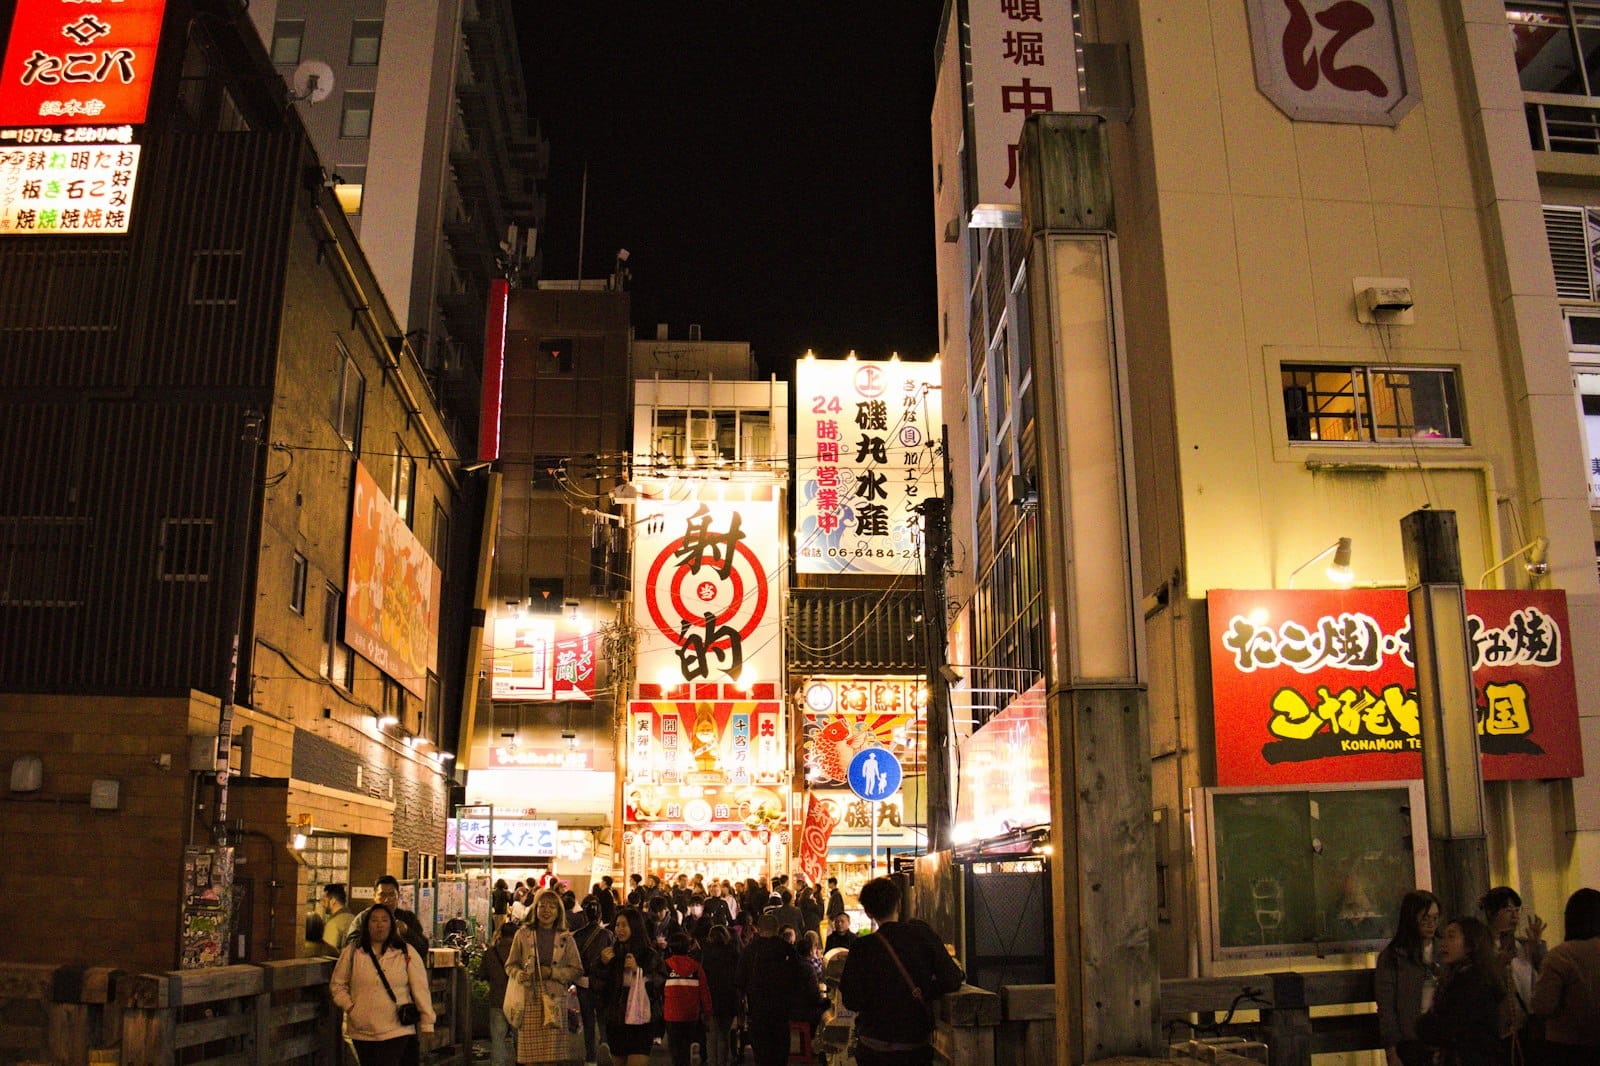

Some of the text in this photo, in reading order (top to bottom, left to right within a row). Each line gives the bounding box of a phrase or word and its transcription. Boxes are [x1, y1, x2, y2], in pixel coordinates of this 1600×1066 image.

[15, 150, 46, 229] 鉄板焼
[60, 150, 91, 229] 明石焼
[82, 150, 112, 229] たこ焼
[105, 150, 134, 229] お好み焼
[812, 395, 842, 534] 24時間営業中
[854, 399, 889, 536] 磯丸水産
[1341, 738, 1403, 751] KONAMON
[500, 828, 553, 848] 大たこ
